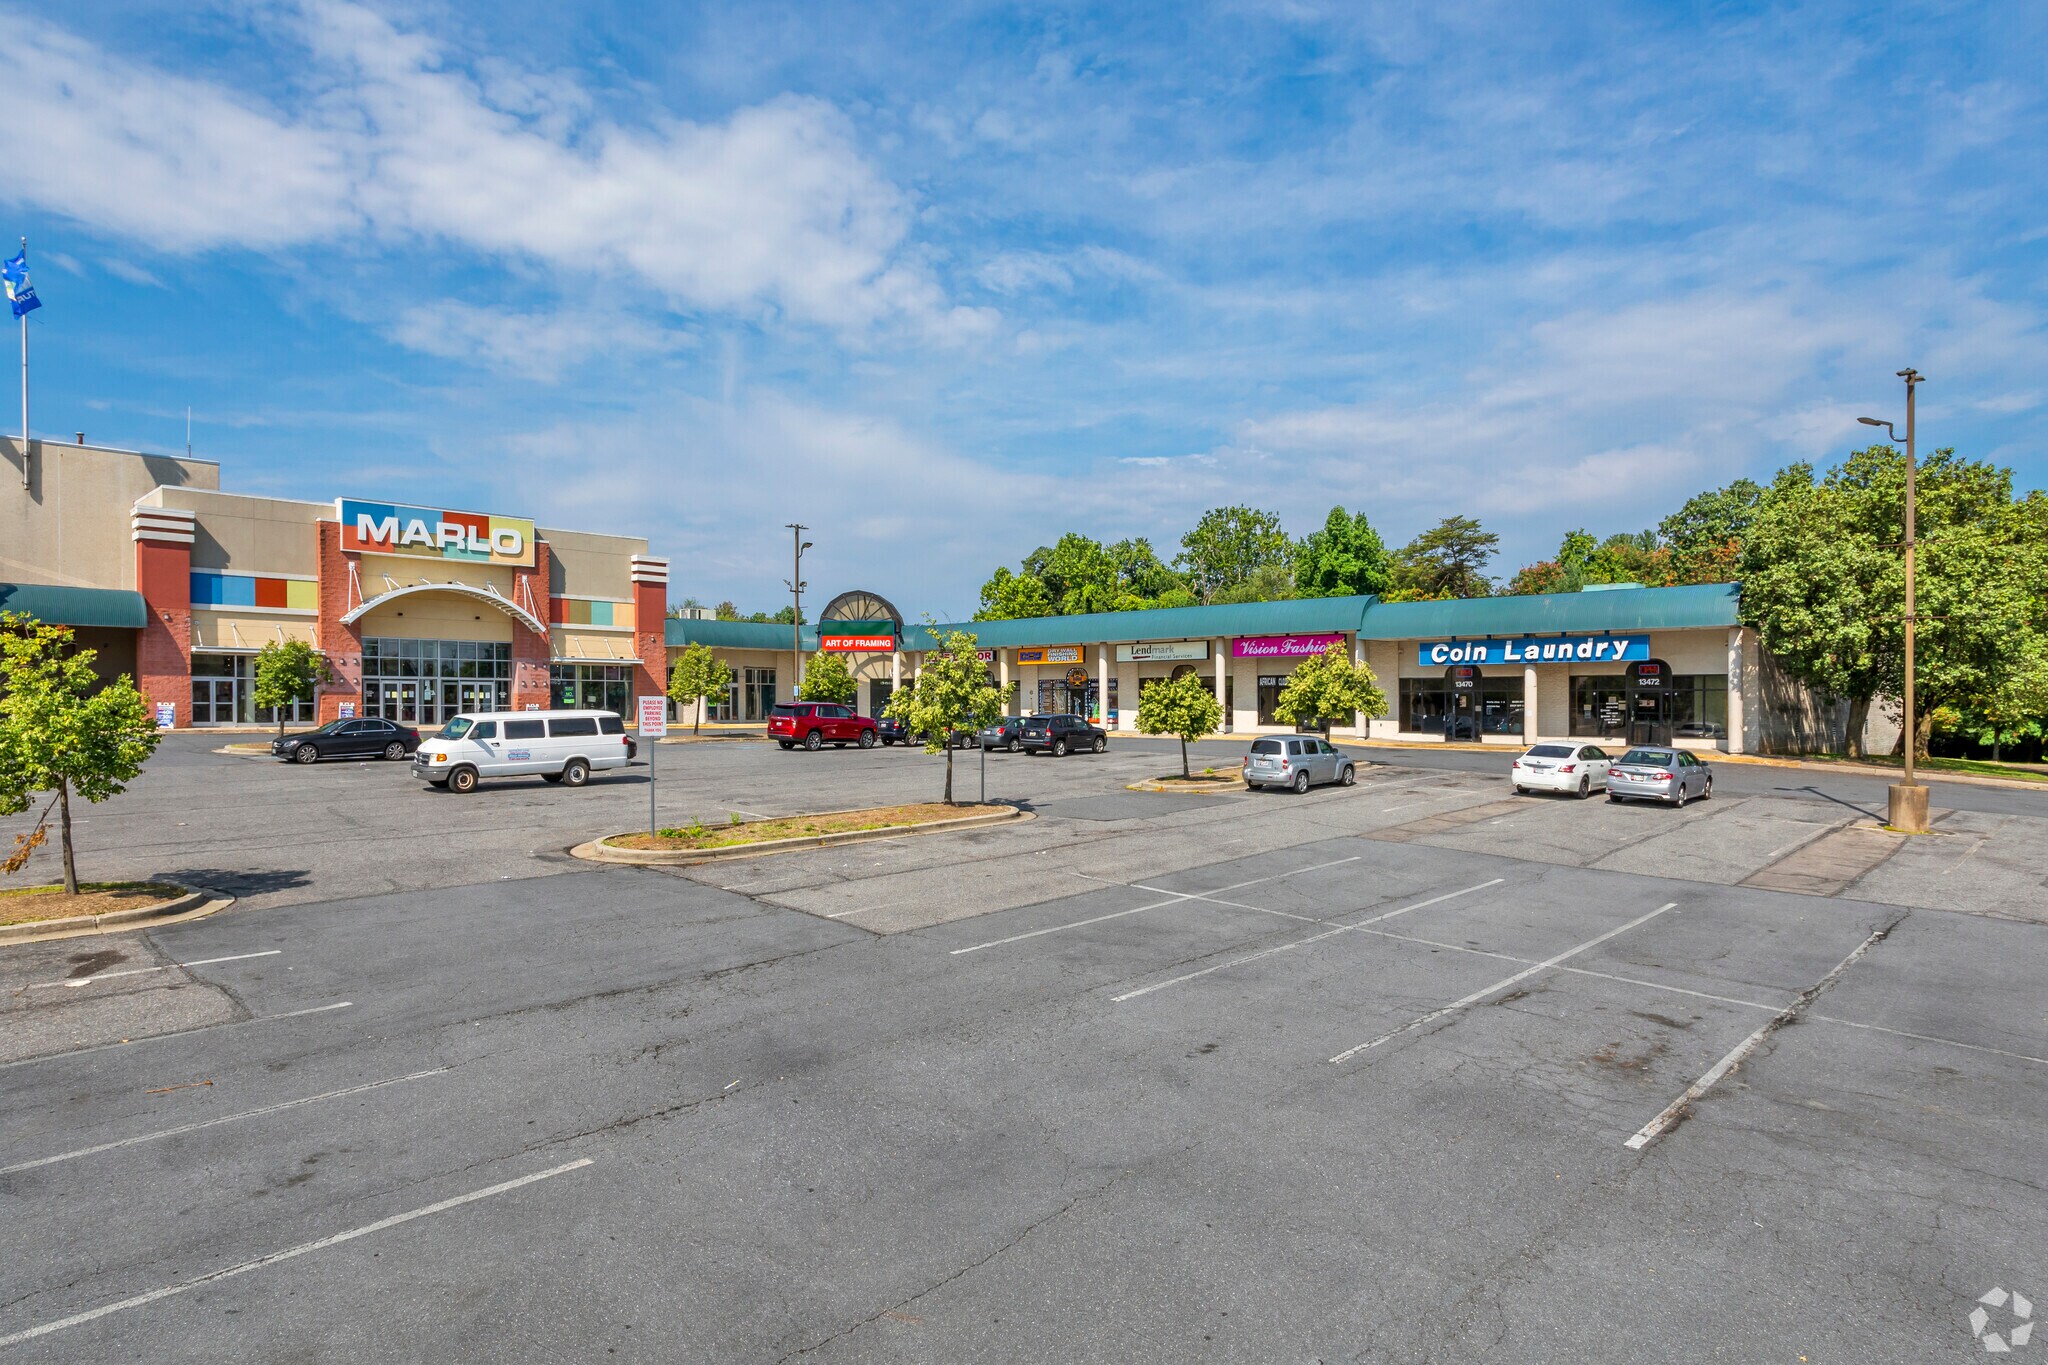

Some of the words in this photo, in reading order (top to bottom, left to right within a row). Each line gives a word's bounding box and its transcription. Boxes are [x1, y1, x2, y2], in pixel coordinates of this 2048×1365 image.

[357, 513, 522, 555] MARLO
[825, 639, 841, 647] ART
[842, 639, 854, 647] OF
[855, 639, 891, 647] FRAMING
[1240, 641, 1278, 654] Vision
[1281, 638, 1328, 654] Fashio
[1131, 645, 1174, 655] Lendmark
[1431, 642, 1487, 663] Coin
[1503, 637, 1629, 661] Laundry
[1259, 677, 1277, 686] AFRICAN
[1639, 678, 1660, 686] 13472
